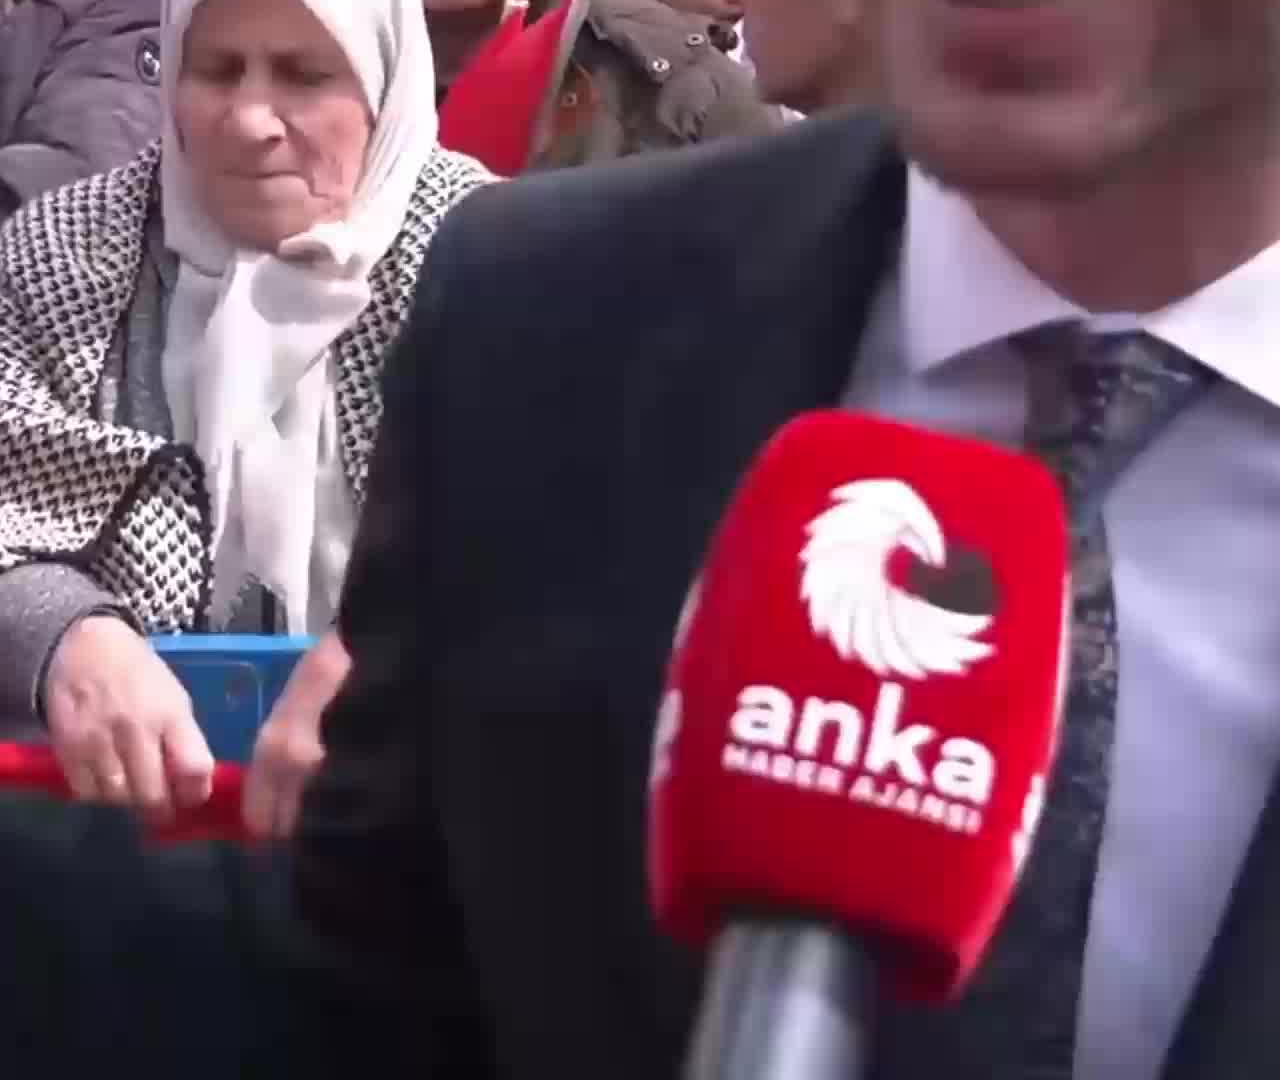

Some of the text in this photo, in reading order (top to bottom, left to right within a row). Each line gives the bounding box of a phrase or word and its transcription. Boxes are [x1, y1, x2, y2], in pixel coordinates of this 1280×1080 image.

[721, 742, 846, 797] HABER
[847, 775, 984, 837] AJANSI
[729, 681, 996, 806] anka
